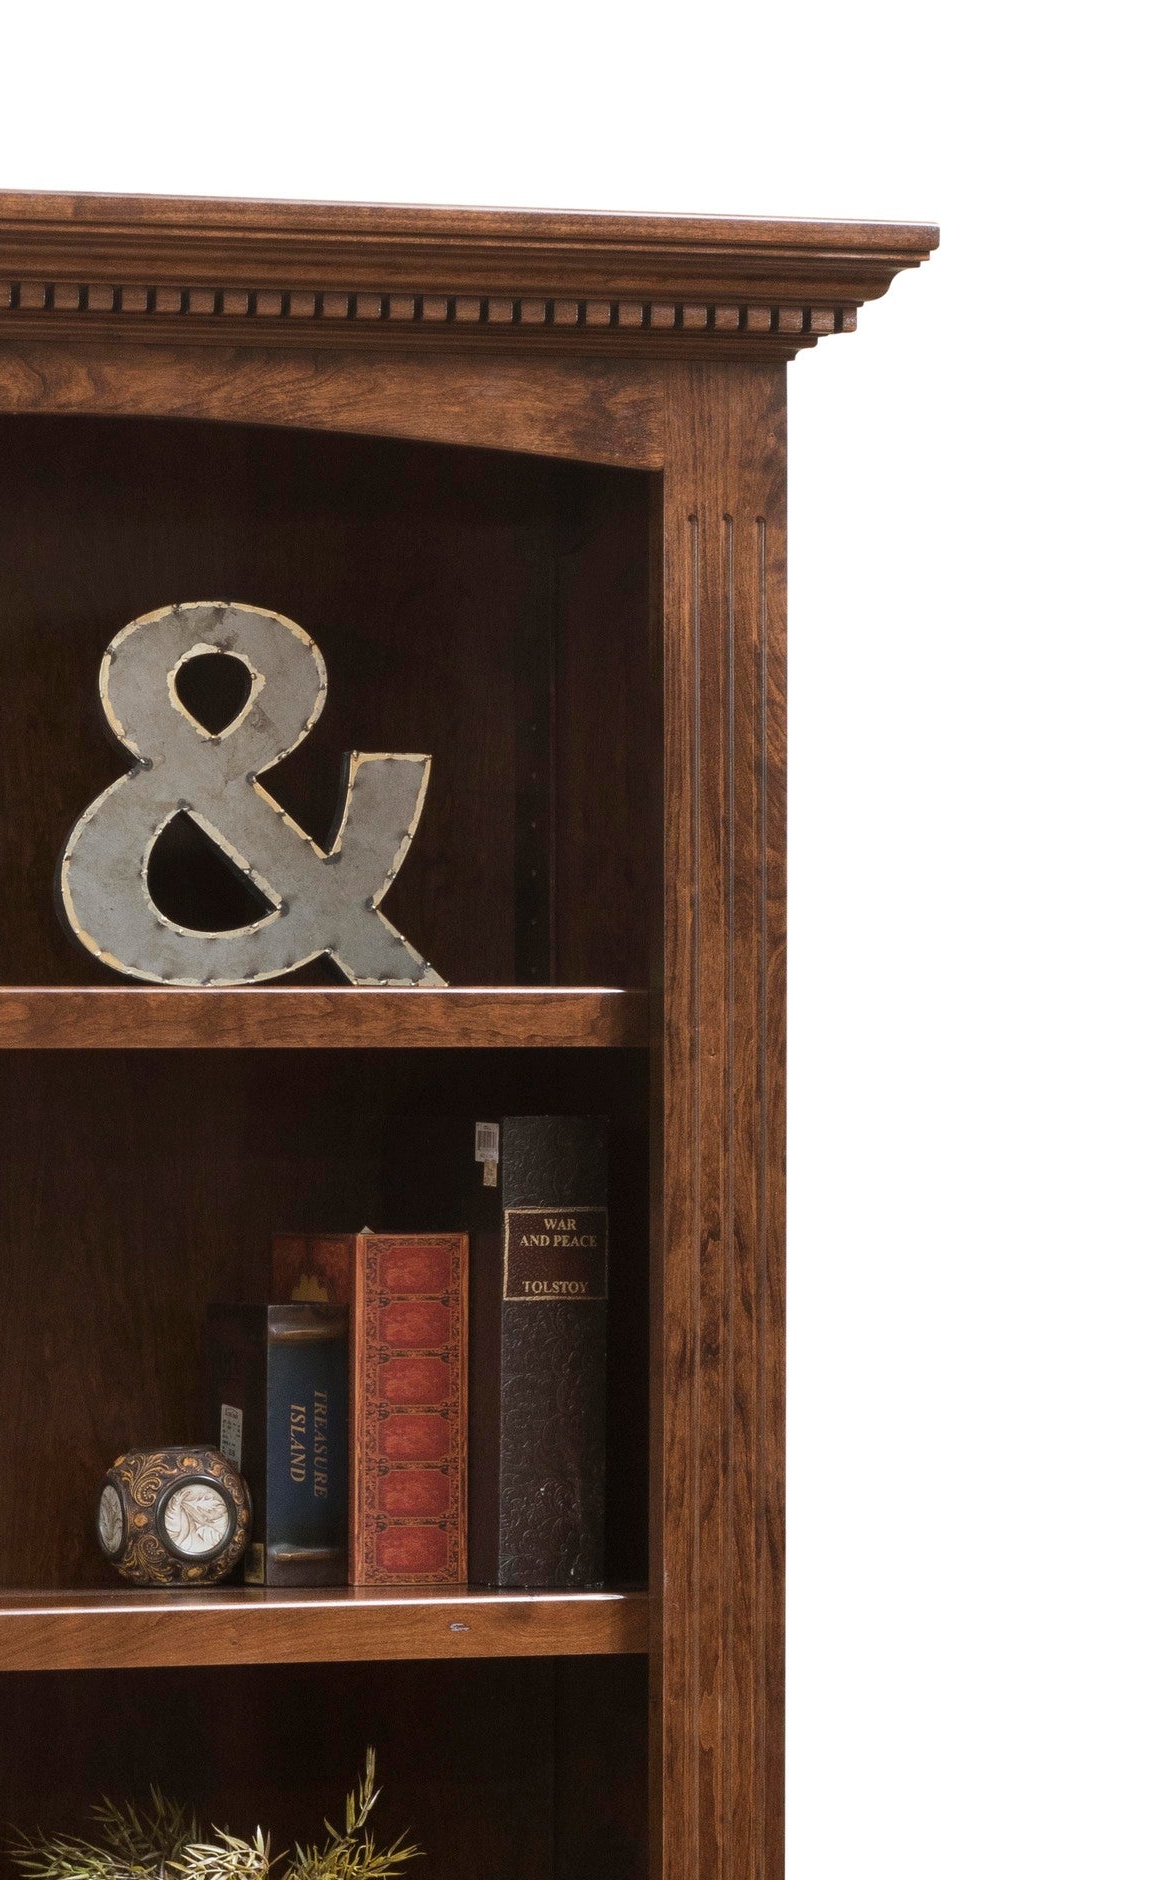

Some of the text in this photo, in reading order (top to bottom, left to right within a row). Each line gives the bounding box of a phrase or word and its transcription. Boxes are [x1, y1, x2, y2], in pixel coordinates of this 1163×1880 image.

[54, 601, 449, 987] &
[520, 1235, 598, 1248] AND PEACE
[544, 1218, 577, 1231] WAR
[521, 1280, 589, 1294] TOLSTOY
[290, 1403, 306, 1482] ISLAND
[313, 1390, 328, 1498] TREASURE
